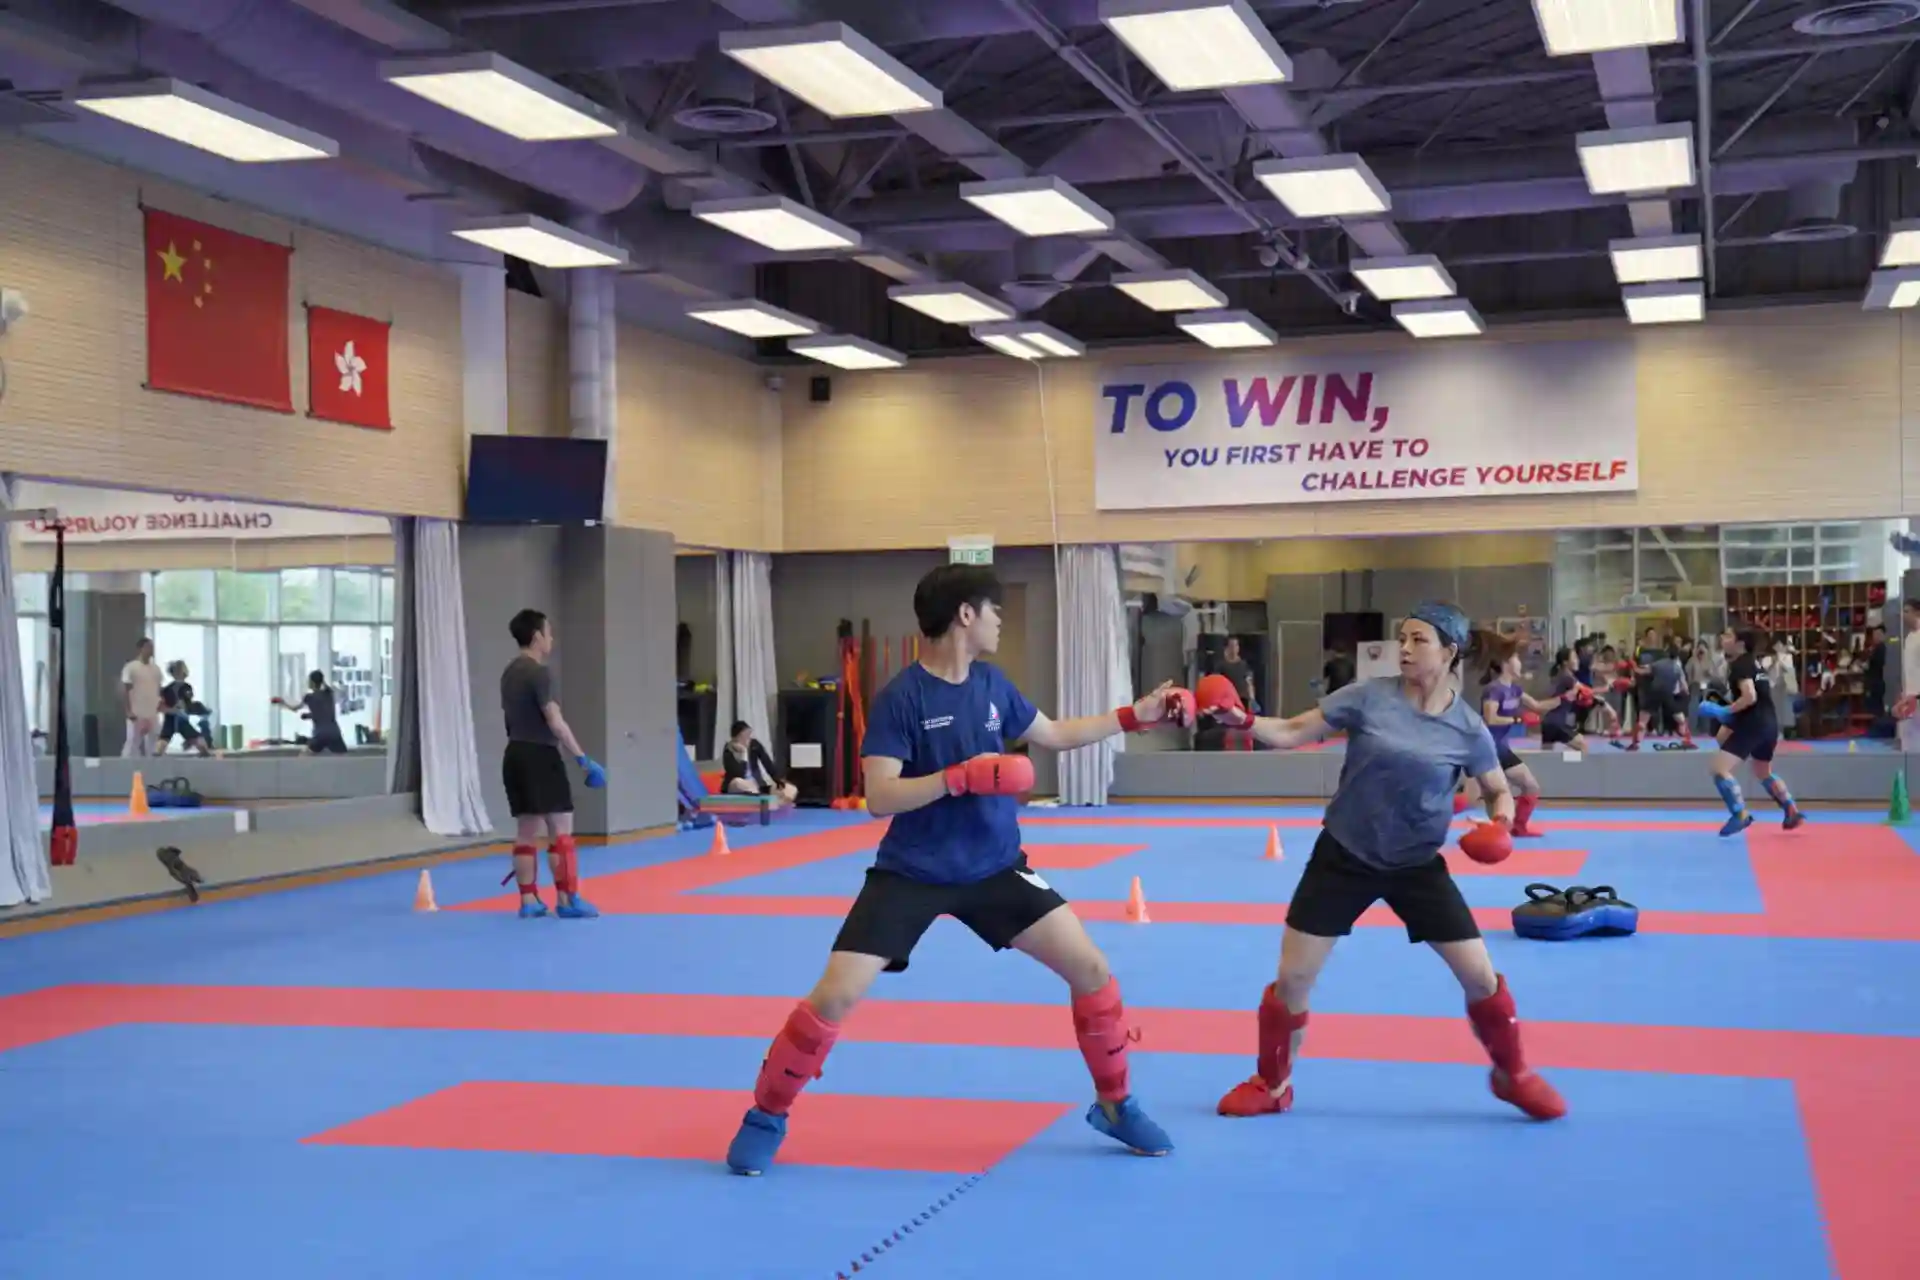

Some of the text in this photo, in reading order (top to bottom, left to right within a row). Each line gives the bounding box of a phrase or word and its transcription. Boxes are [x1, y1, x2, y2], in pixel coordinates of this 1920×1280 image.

[1103, 372, 1389, 433] TO WIN,
[1165, 438, 1429, 467] YOU FIRST HAVE TO
[1302, 460, 1627, 491] CHALLENGE YOURSELF
